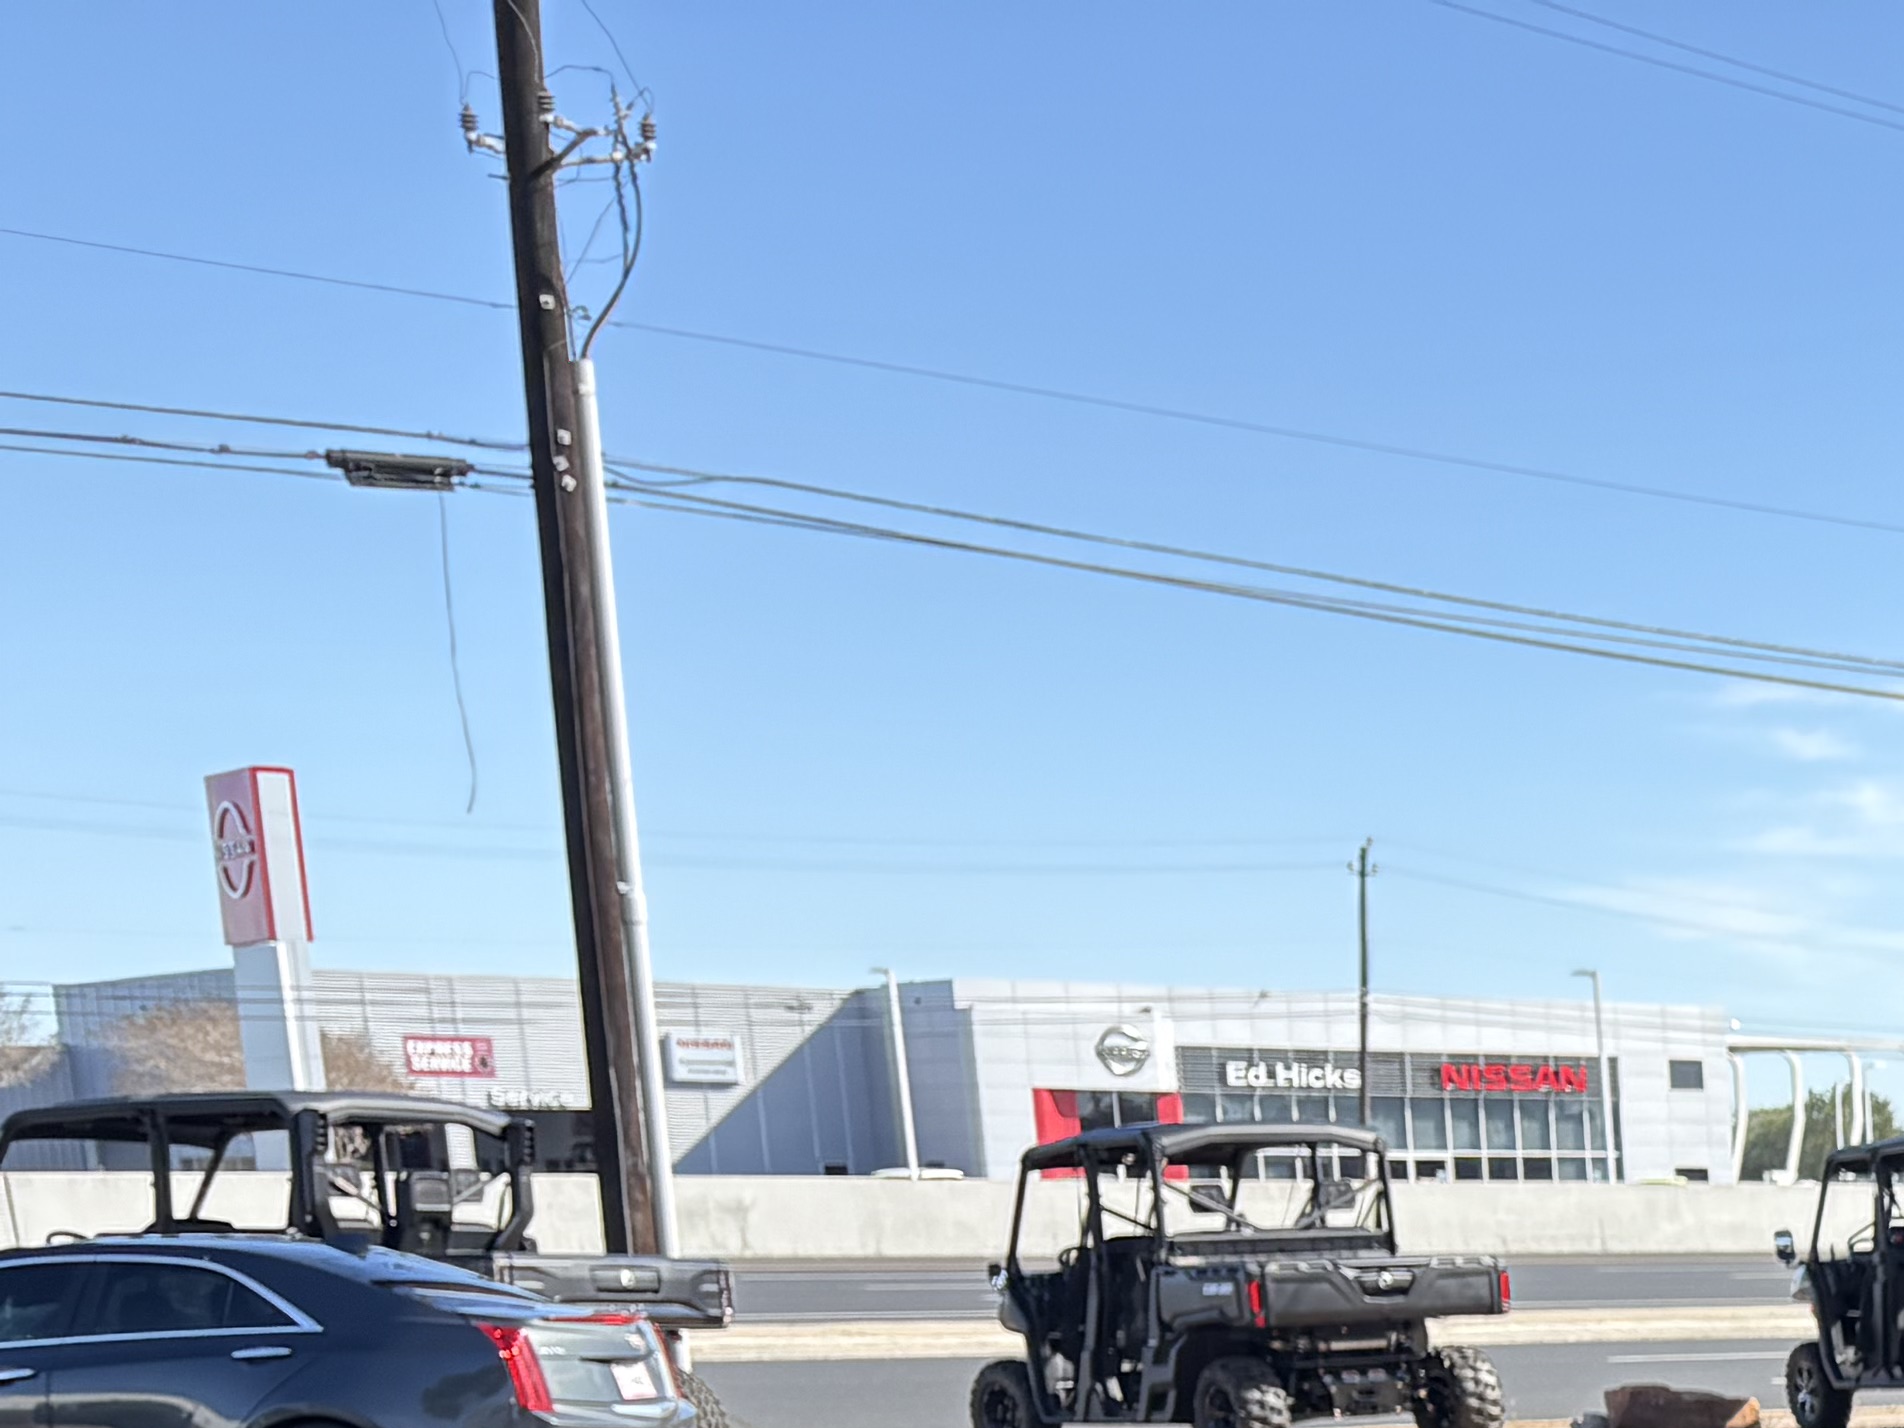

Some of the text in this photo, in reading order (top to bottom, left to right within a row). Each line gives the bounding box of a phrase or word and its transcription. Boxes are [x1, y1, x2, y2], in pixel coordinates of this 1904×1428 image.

[406, 1039, 473, 1058] EXPRESS
[1226, 1061, 1362, 1090] Ed Hicks
[1439, 1062, 1588, 1092] NISSAN
